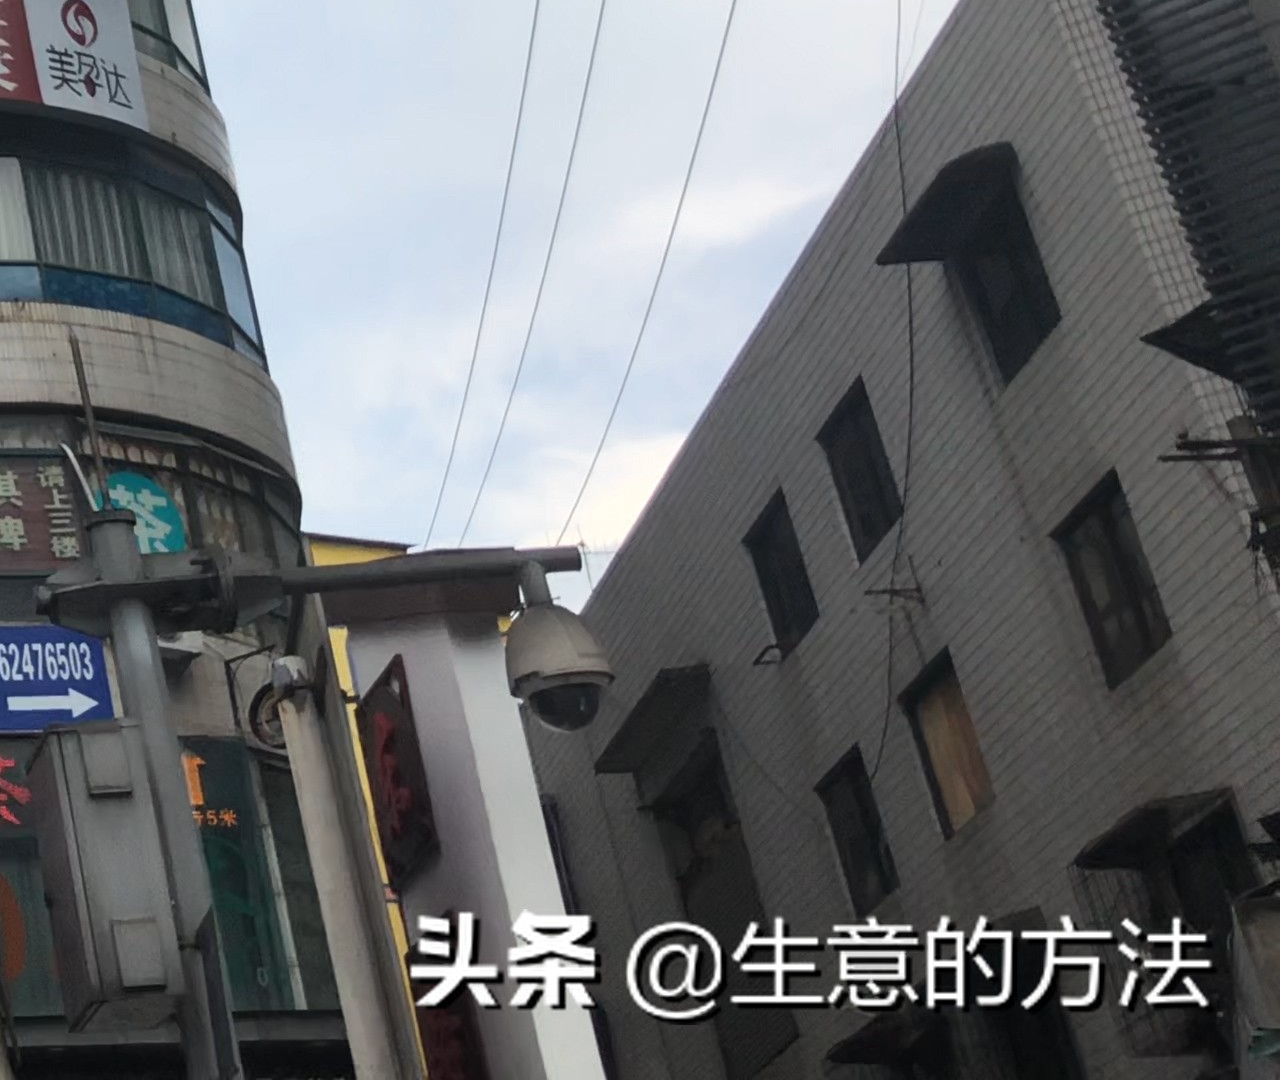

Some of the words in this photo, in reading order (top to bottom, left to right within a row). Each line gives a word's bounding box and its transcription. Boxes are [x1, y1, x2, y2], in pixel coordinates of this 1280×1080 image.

[44, 45, 134, 111] 美孕达
[37, 464, 81, 559] 请上三楼
